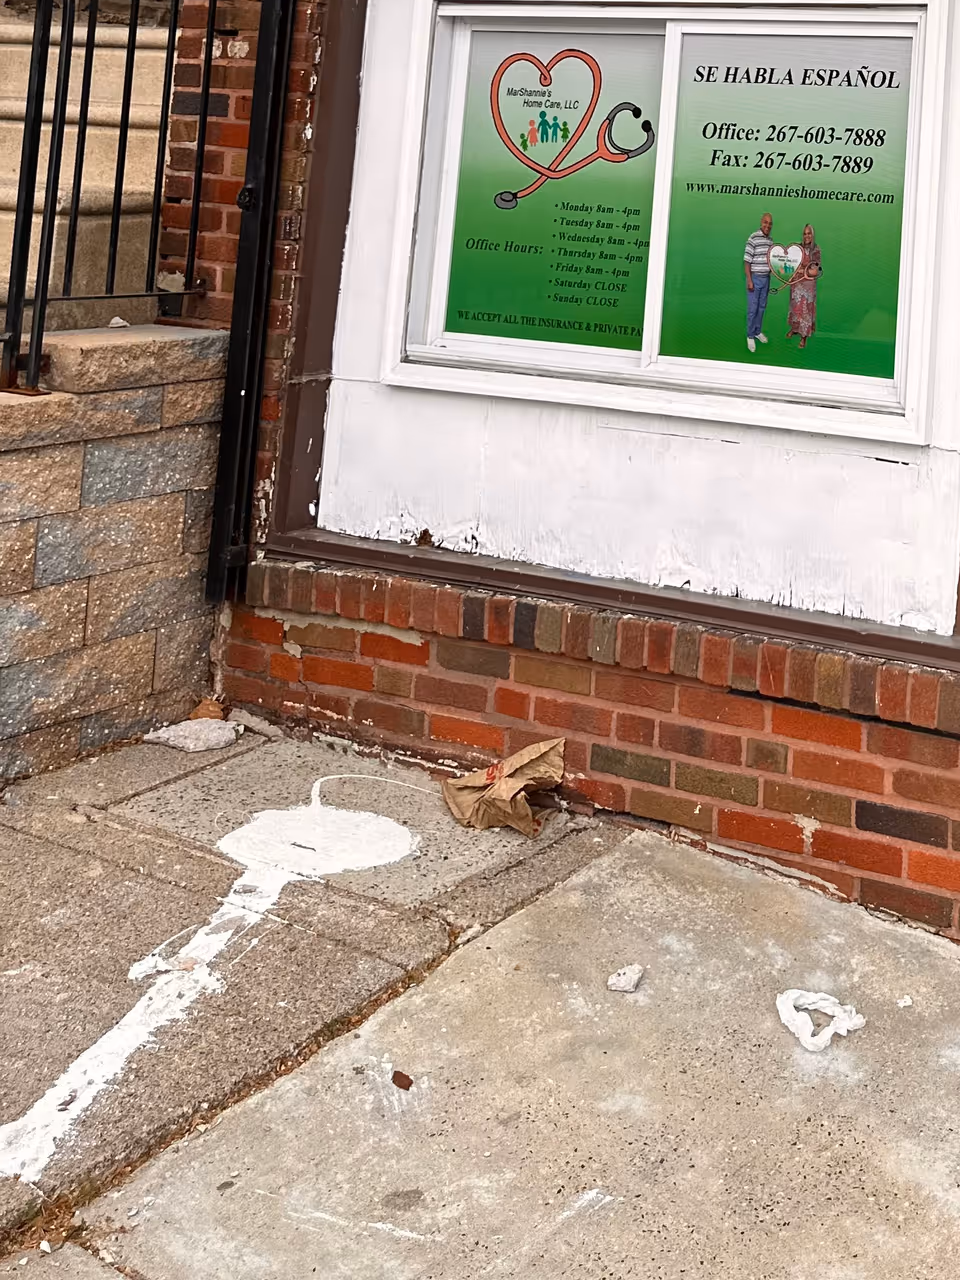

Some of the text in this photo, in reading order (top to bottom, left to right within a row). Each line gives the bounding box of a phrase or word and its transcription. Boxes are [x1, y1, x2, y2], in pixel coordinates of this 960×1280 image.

[693, 66, 900, 89] SE HABLA ESPAÑOL
[506, 88, 552, 97] MarShannie's
[523, 99, 579, 110] Home Care, LLC
[702, 122, 886, 147] Office: 267-603-7888
[709, 149, 874, 174] Fax: 267-603-7889
[686, 181, 895, 204] www.marshannieshomecare.com
[560, 202, 594, 214] Monday
[596, 205, 614, 213] 8am
[622, 207, 641, 217] 4pm
[560, 217, 593, 229] Tuesday
[595, 220, 613, 229] 8am
[621, 222, 640, 232] 4pm
[465, 238, 544, 255] Office Hours:
[559, 232, 605, 246] Wednesday
[607, 236, 625, 246] 8am
[557, 248, 597, 260] Thursday
[598, 251, 616, 260] 8am
[624, 252, 643, 263] 4pm
[555, 263, 582, 275] Friday
[585, 265, 603, 275] 8am
[611, 267, 630, 278] 4pm
[554, 278, 627, 292] Saturday CLOSE
[553, 293, 619, 307] Sunday CLOSE
[457, 310, 470, 320] WE
[471, 312, 502, 323] ACCEPT
[503, 315, 519, 324] ALL
[520, 316, 537, 326] THE
[538, 318, 583, 331] INSURANCE
[585, 323, 592, 331] &
[593, 324, 629, 335] PRIVATE
